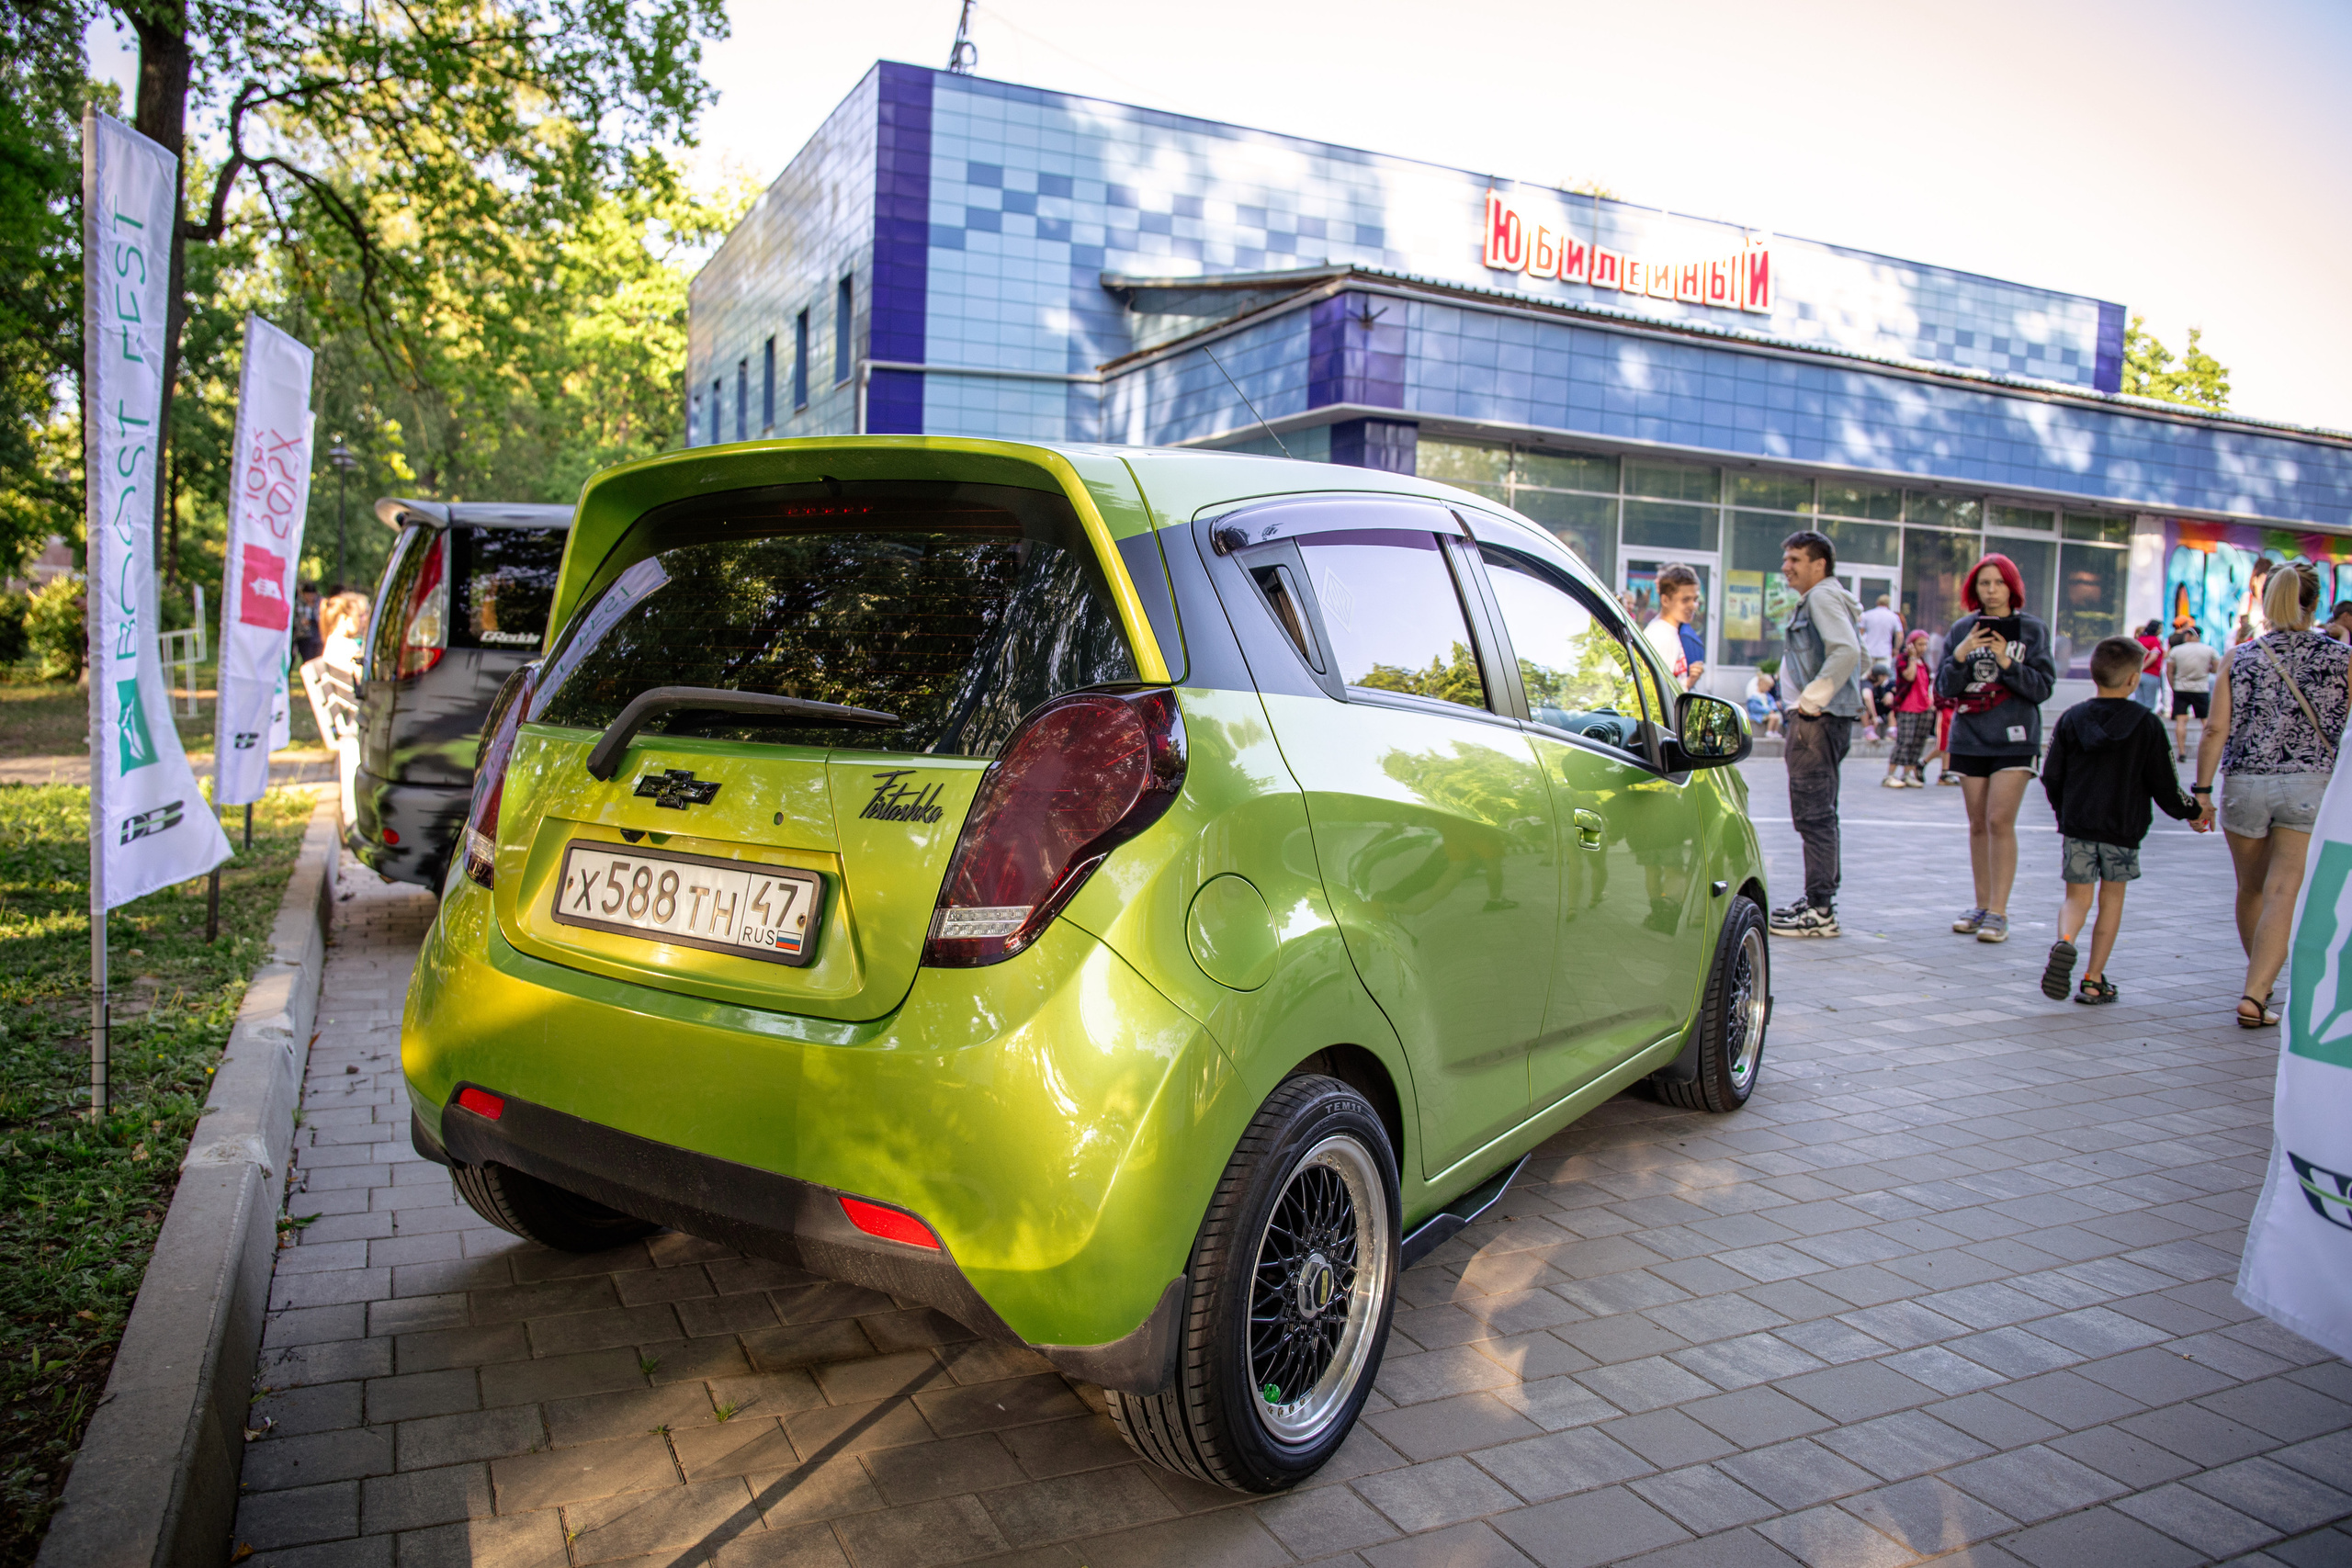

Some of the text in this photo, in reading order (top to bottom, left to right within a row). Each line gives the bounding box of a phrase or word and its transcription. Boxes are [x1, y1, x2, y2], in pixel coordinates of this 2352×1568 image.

[858, 770, 944, 824] Fistashka
[751, 880, 798, 929] 47
[742, 926, 775, 945] RUS
